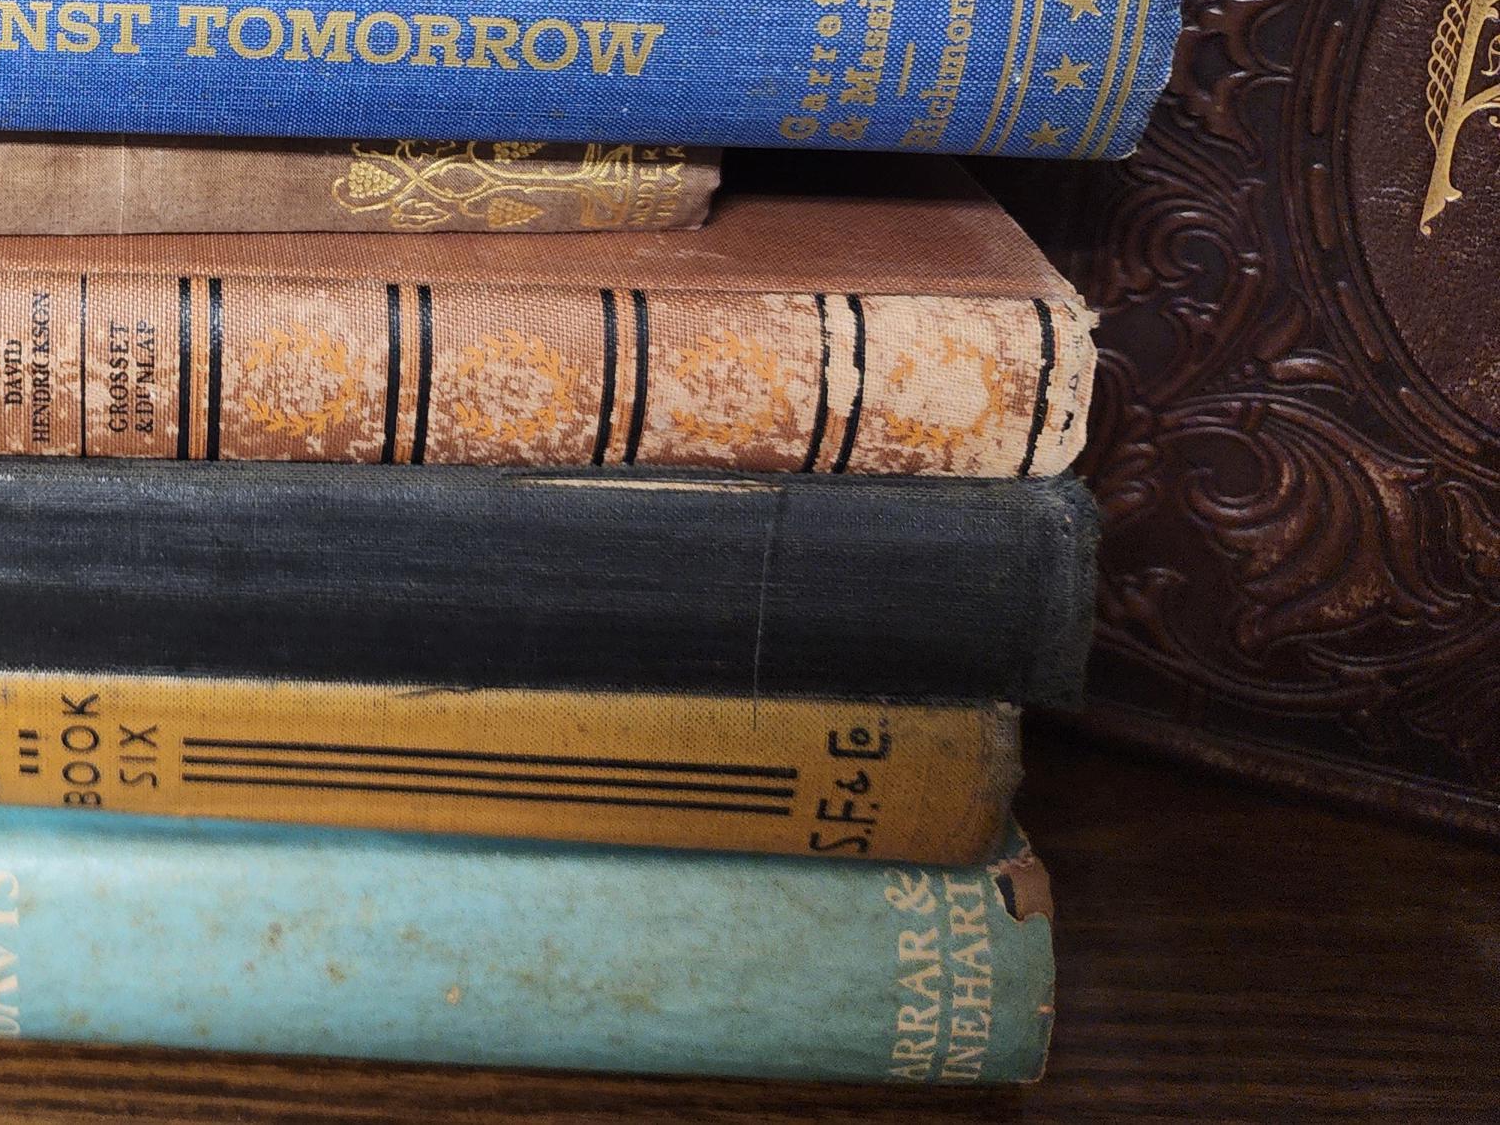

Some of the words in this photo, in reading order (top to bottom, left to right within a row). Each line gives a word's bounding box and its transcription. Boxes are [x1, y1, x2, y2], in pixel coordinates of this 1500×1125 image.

[177, 4, 669, 78] TOMORROW
[828, 114, 870, 142] &
[3, 339, 23, 406] DAVID
[32, 291, 51, 444] HENDRICKSON
[108, 320, 130, 434] GROSSET
[60, 693, 103, 806] BOOK
[118, 724, 159, 789] SIX
[883, 868, 938, 915] &
[887, 925, 943, 1081] ARRAR
